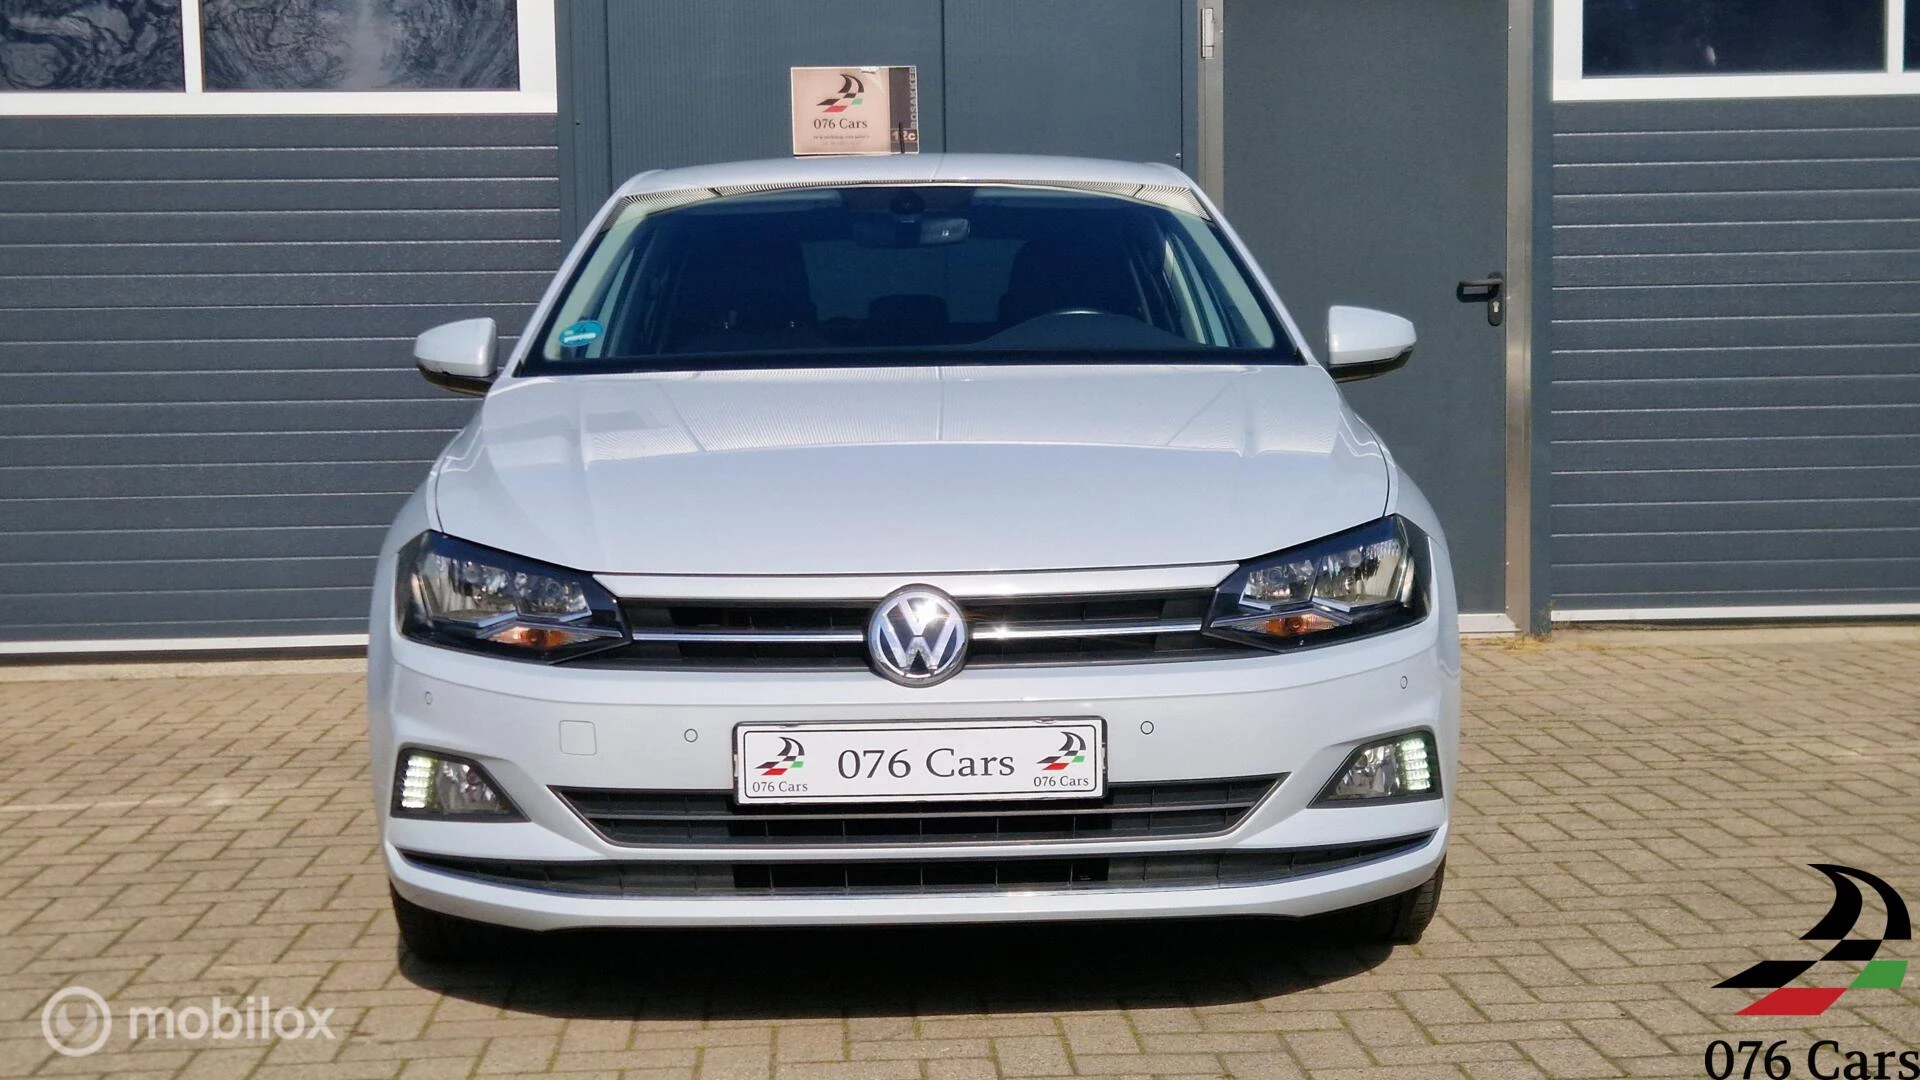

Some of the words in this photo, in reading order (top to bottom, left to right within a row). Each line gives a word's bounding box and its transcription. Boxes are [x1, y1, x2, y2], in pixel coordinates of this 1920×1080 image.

[813, 118, 836, 129] 076
[839, 118, 868, 129] Cars
[837, 748, 912, 779] 076
[926, 748, 1015, 778] Cars
[752, 781, 775, 793] 076
[778, 781, 808, 793] Cars
[1033, 776, 1056, 787] 076
[1059, 775, 1089, 787] Cars
